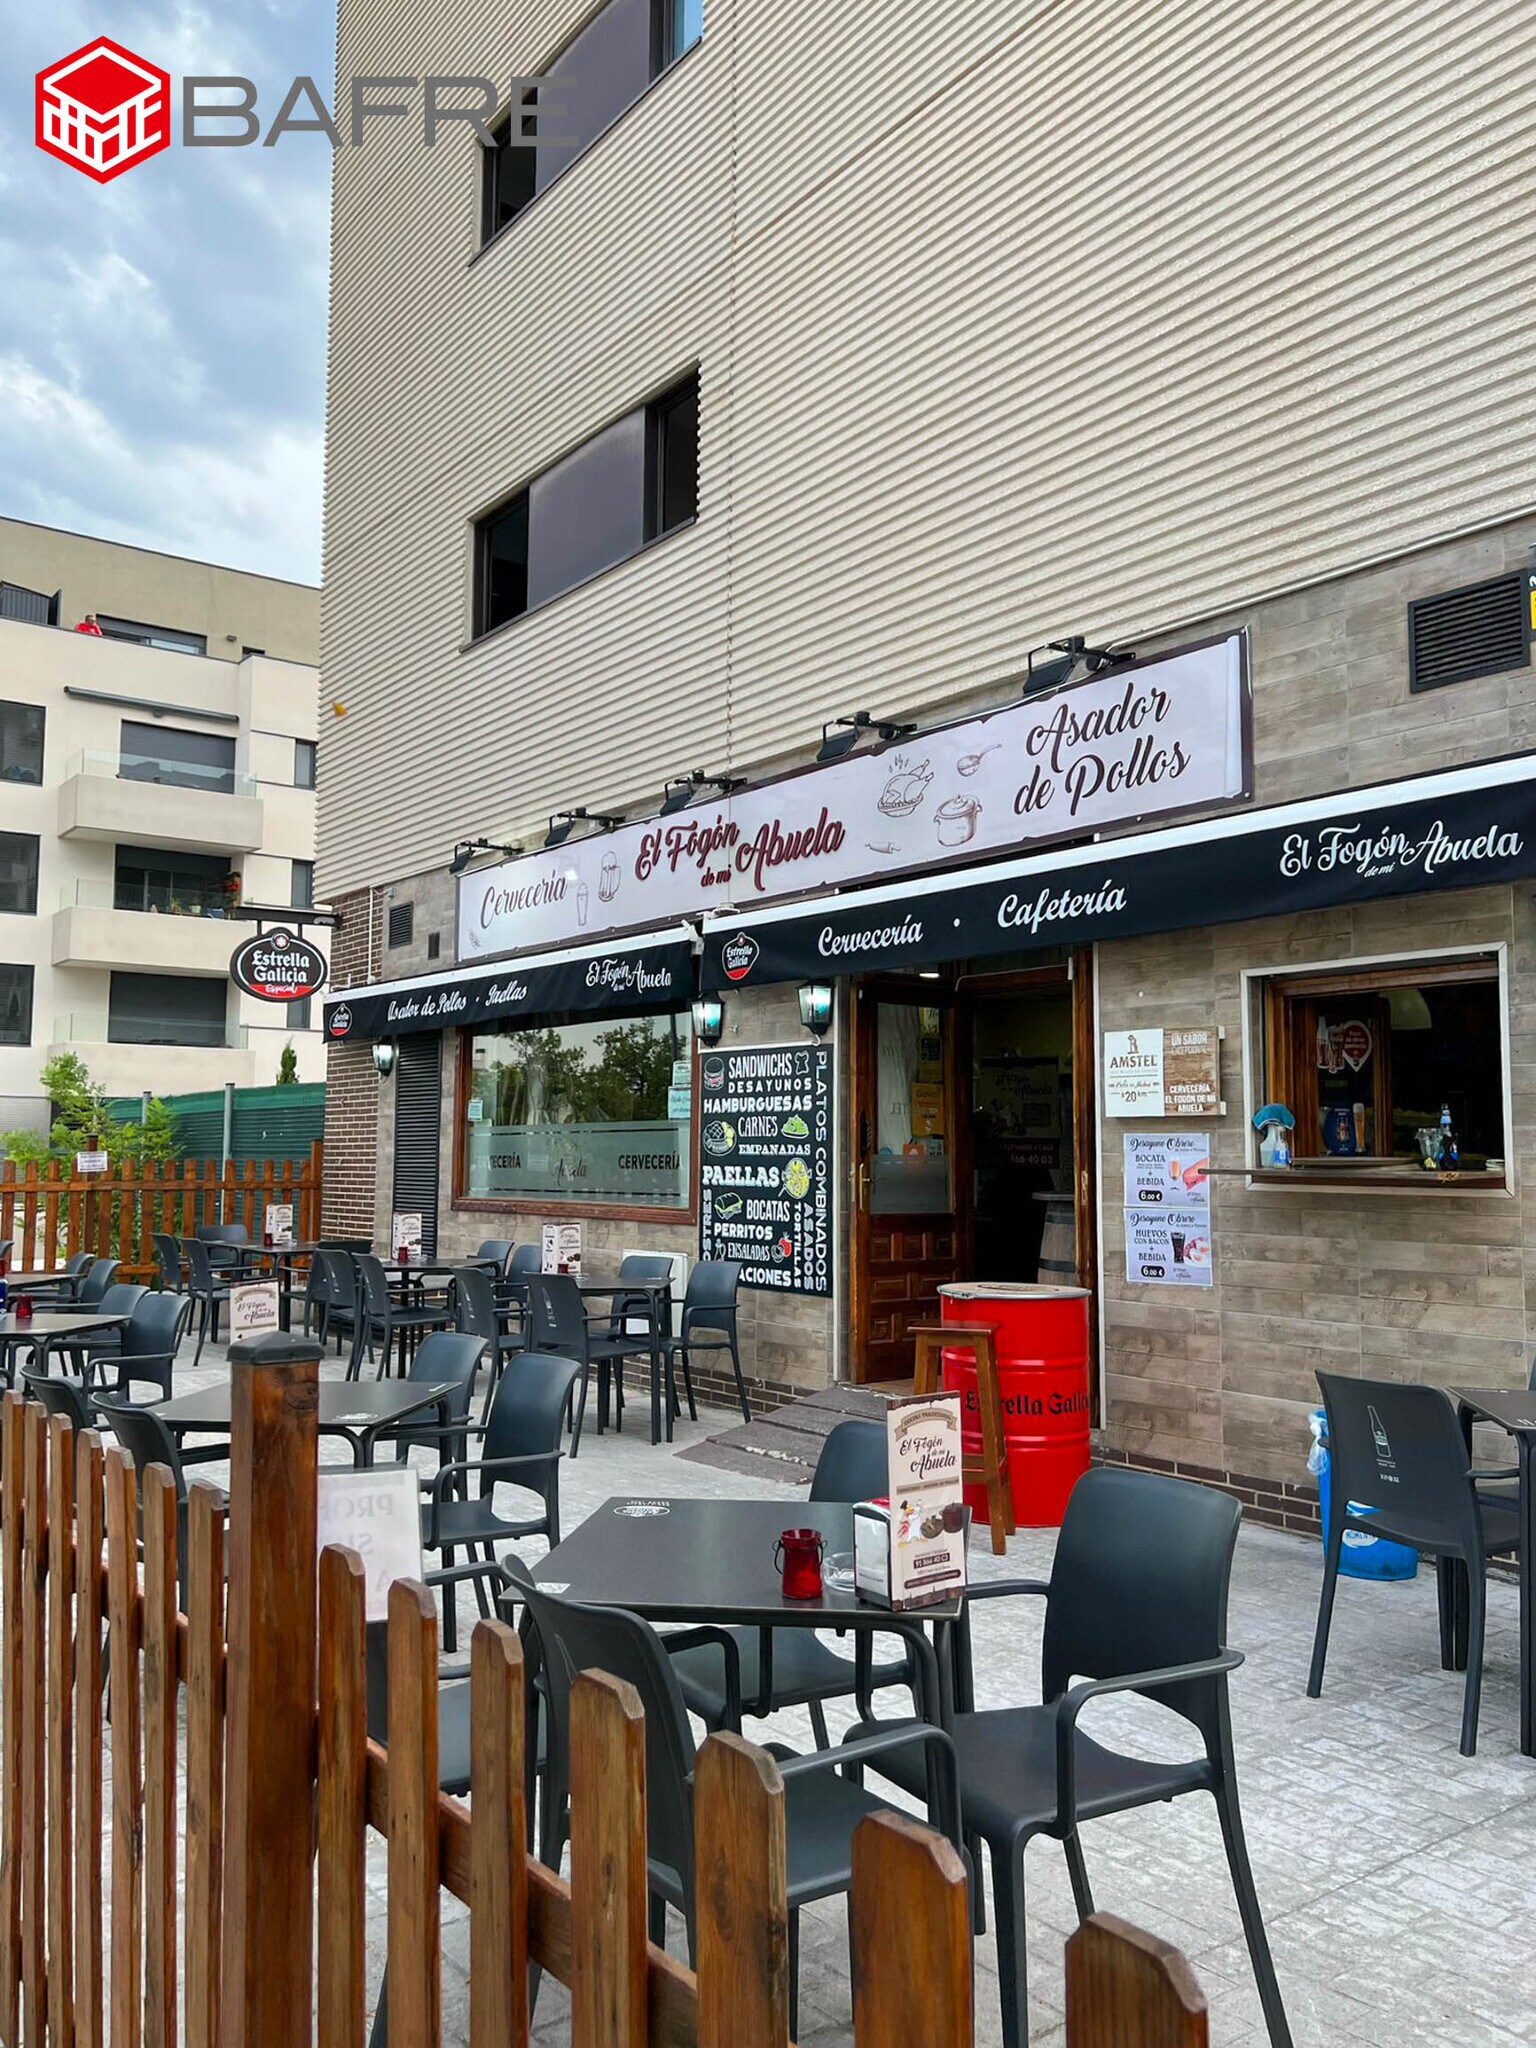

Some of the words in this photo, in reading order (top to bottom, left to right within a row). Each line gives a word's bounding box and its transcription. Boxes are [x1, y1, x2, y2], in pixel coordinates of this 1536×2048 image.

[1026, 682, 1171, 772] Asador
[1014, 764, 1055, 815] de
[1065, 734, 1190, 816] Pollos
[635, 834, 660, 881] El
[666, 814, 739, 872] Fogón
[736, 807, 845, 891] Abuela
[1280, 834, 1312, 877] El
[1317, 823, 1408, 874] Fogón
[1401, 820, 1523, 873] Abuela
[701, 871, 715, 887] de
[716, 863, 731, 884] mi
[480, 869, 568, 929] Cervecería
[818, 914, 924, 957] Cervecería
[998, 879, 1127, 934] Cafetería
[251, 950, 310, 968] Estrella
[727, 945, 752, 957] Estrella
[728, 956, 748, 968] Galicia
[253, 966, 308, 983] Galicia
[586, 961, 600, 987] El
[601, 959, 629, 987] Fogón
[626, 960, 672, 994] Abuela
[265, 983, 299, 994] Especial
[388, 998, 419, 1021] Asador
[421, 995, 435, 1016] de
[436, 991, 466, 1014] Pollos
[728, 1053, 792, 1079] SANDWICHS
[1110, 1055, 1157, 1069] AMSTEL
[728, 1078, 812, 1093] DESAYUNOS
[815, 1051, 827, 1141] PLATOS
[1125, 1091, 1137, 1102] 20
[703, 1095, 813, 1114] HAMBURGUESAS
[738, 1116, 778, 1137] CARNES
[738, 1144, 811, 1156] EMPANADAS
[1135, 1155, 1165, 1163] BOCATA
[702, 1165, 780, 1188] PAELLAS
[1137, 1177, 1164, 1186] BEBIDA
[746, 1199, 790, 1222] BOCATAS
[815, 1147, 827, 1291] COMBINADOS
[702, 1189, 712, 1261] OSTRES
[714, 1223, 773, 1241] PERRITOS
[1136, 1229, 1167, 1238] HUEVOS
[727, 1242, 770, 1261] ENSALADAS
[793, 1202, 802, 1288] TORTILLAS
[803, 1203, 814, 1290] ASADOS
[1138, 1252, 1166, 1262] BEBIDA
[738, 1267, 792, 1287] ACIONES
[899, 1437, 911, 1456] El
[910, 1450, 956, 1480] Abuela
